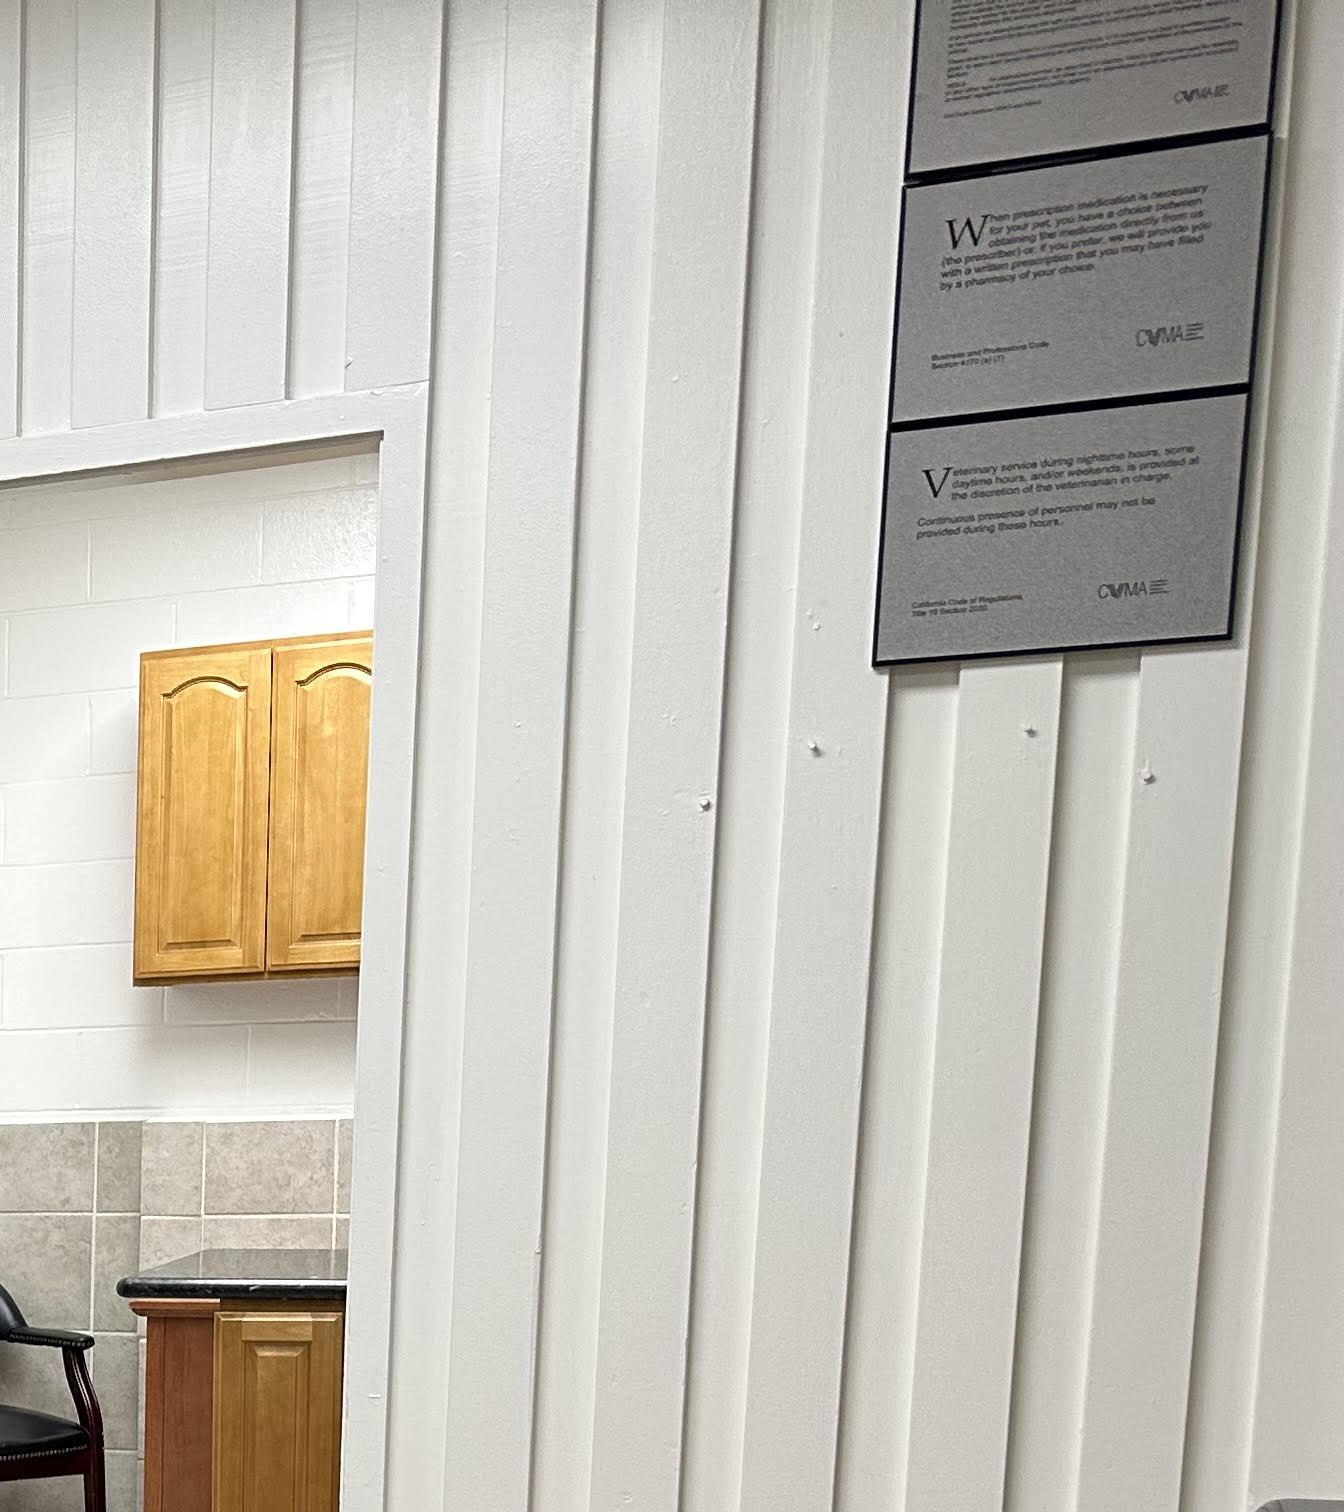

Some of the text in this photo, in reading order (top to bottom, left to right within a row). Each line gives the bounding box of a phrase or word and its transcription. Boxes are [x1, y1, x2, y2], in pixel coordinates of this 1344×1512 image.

[1151, 185, 1208, 199] necessary
[1006, 223, 1029, 235] your
[1055, 217, 1076, 228] you
[1078, 212, 1104, 222] have
[1116, 204, 1153, 217] choice
[1059, 222, 1118, 237] medication
[1120, 215, 1159, 229] directly
[1049, 240, 1069, 251] you
[1148, 224, 1189, 238] provide
[1011, 253, 1074, 270] prescription
[1099, 247, 1119, 258] you
[1121, 244, 1145, 254] may
[1148, 239, 1175, 250] have
[939, 281, 953, 291] by
[1018, 269, 1031, 279] of
[1032, 267, 1057, 279] your
[1001, 461, 1038, 472] service
[1040, 457, 1073, 468] during
[1076, 452, 1125, 465] nighttime
[1164, 446, 1195, 455] some
[952, 477, 993, 489] daytime
[1139, 457, 1186, 471] provided
[952, 491, 968, 500] the
[970, 487, 1020, 499] discretion
[1022, 484, 1034, 494] of
[1036, 483, 1053, 493] the
[917, 496, 1156, 527] Continuous presence of personnel may not be
[916, 525, 961, 540] provided
[963, 523, 995, 534] during
